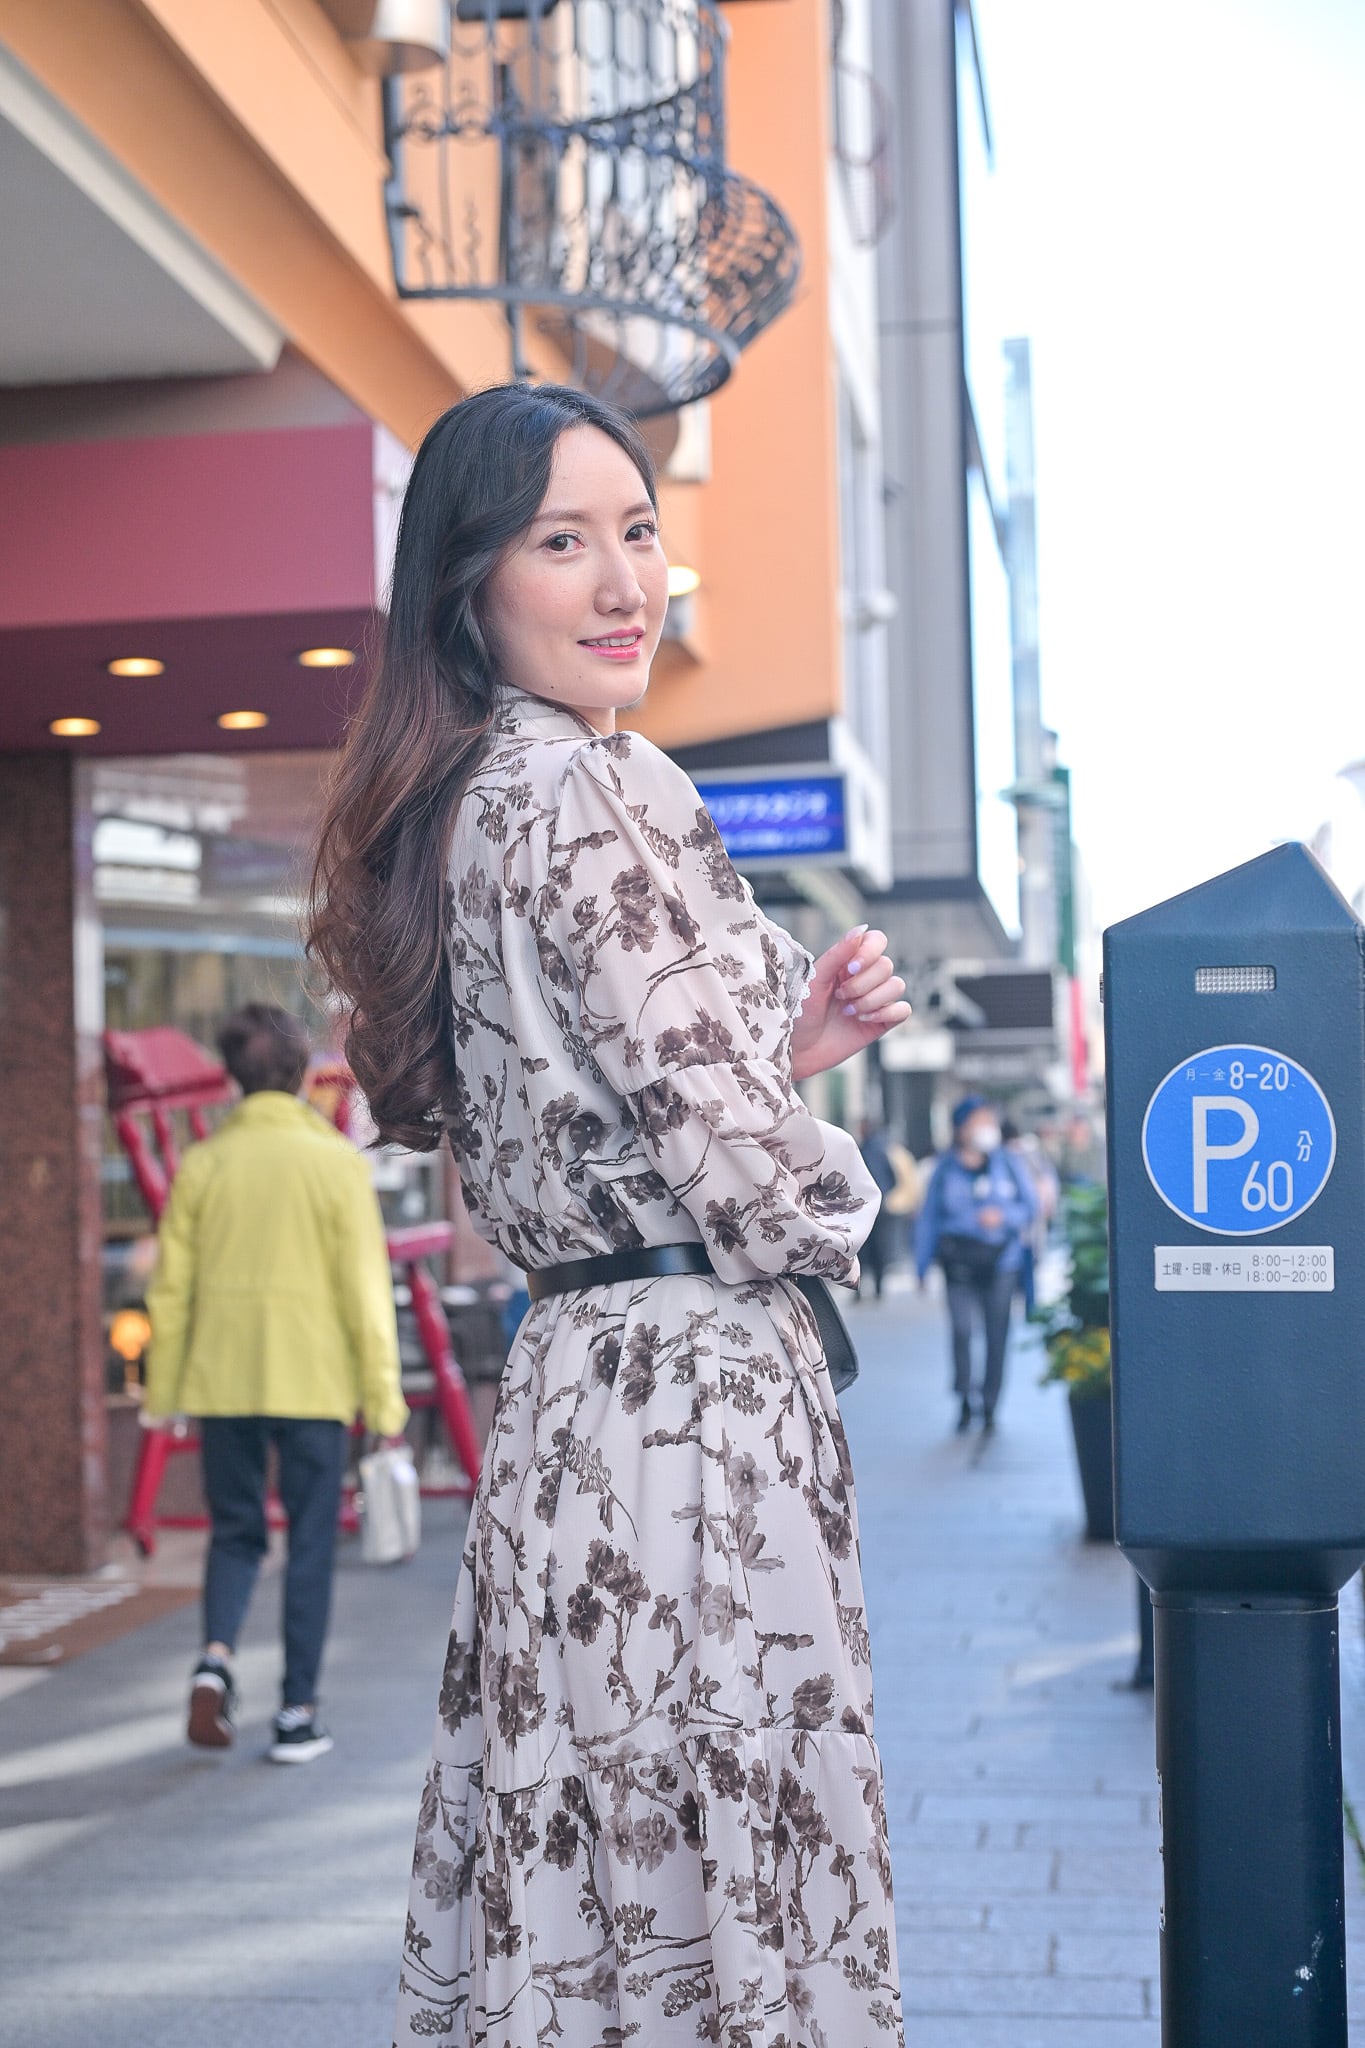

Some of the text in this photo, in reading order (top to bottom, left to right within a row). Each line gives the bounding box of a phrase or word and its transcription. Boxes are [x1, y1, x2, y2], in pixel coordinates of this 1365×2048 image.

[1192, 1095, 1260, 1214] P
[1241, 1130, 1313, 1213] 60 分
